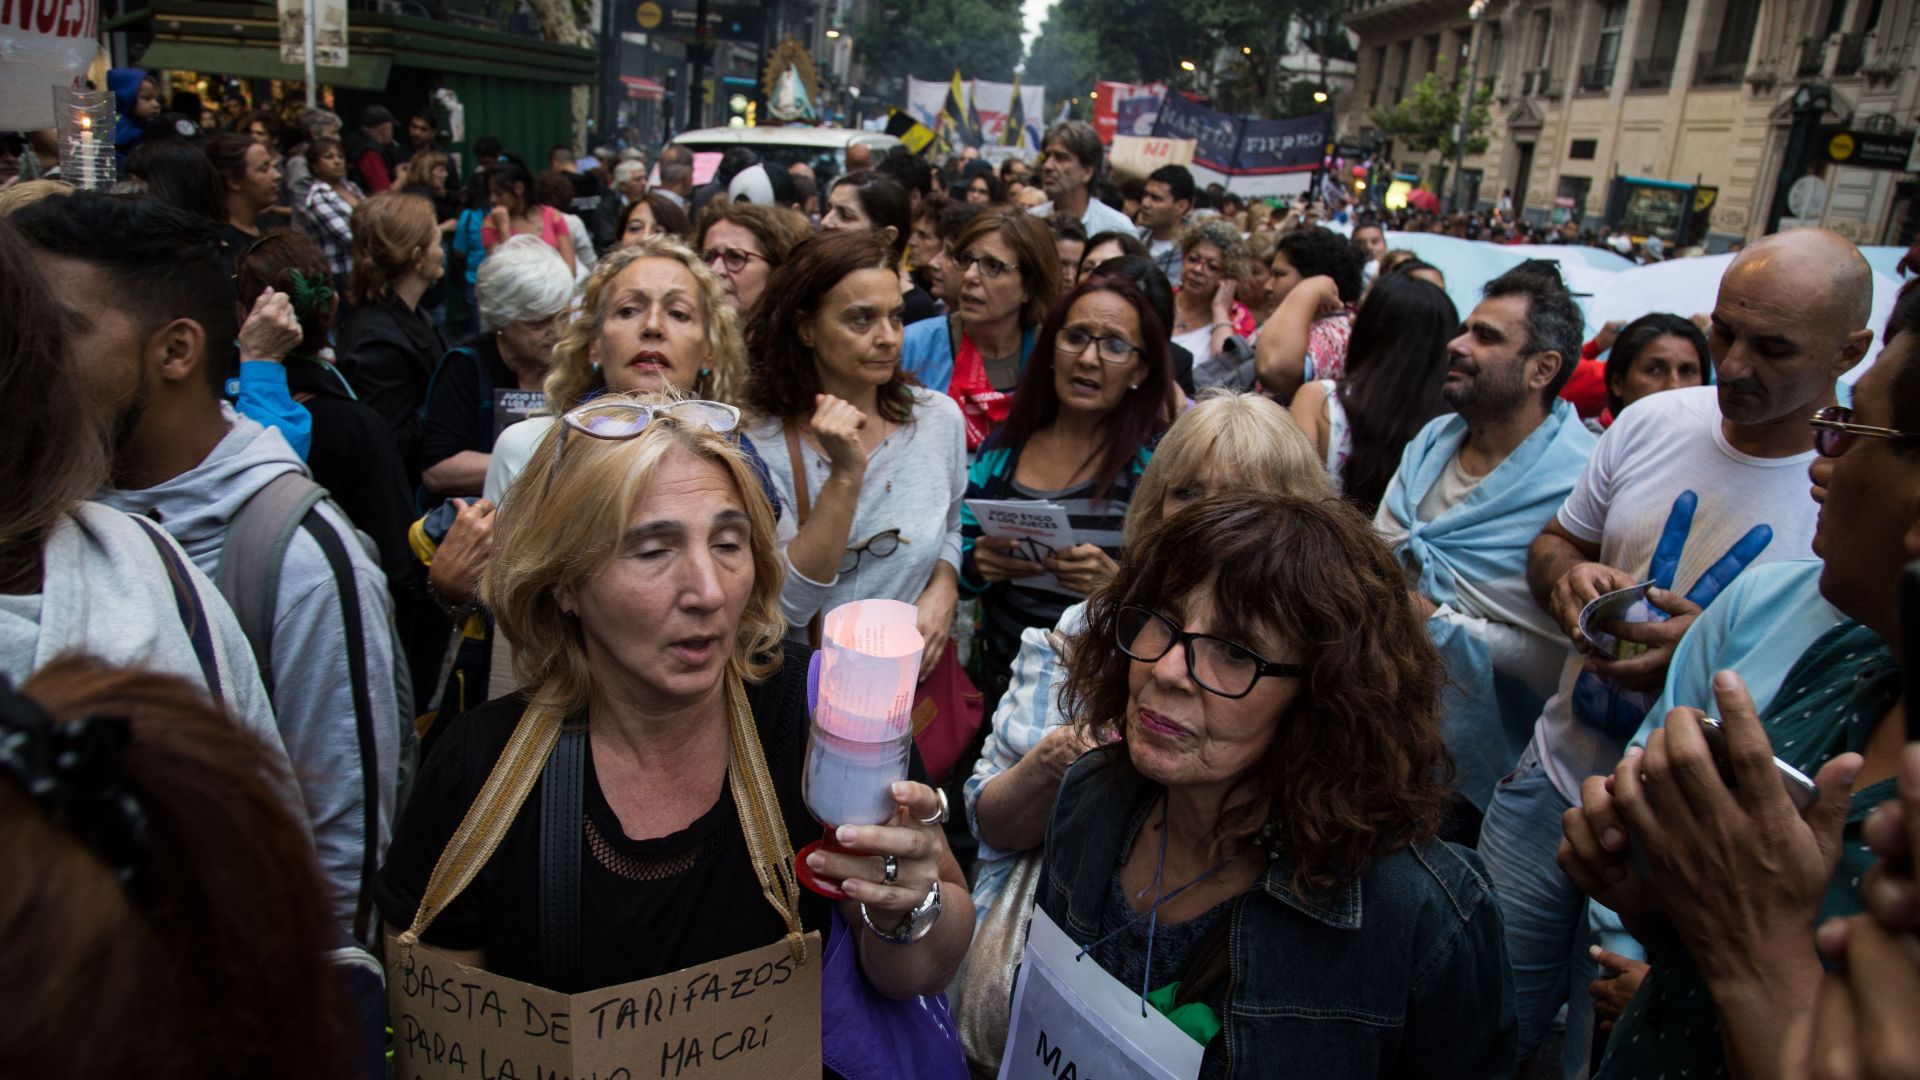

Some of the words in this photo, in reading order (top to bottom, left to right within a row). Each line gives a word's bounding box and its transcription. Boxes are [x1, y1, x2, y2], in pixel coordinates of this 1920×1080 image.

[402, 954, 507, 1028] BASTA
[521, 997, 570, 1045] DE
[402, 1014, 468, 1074] PARA
[1036, 1029, 1090, 1080] MA
